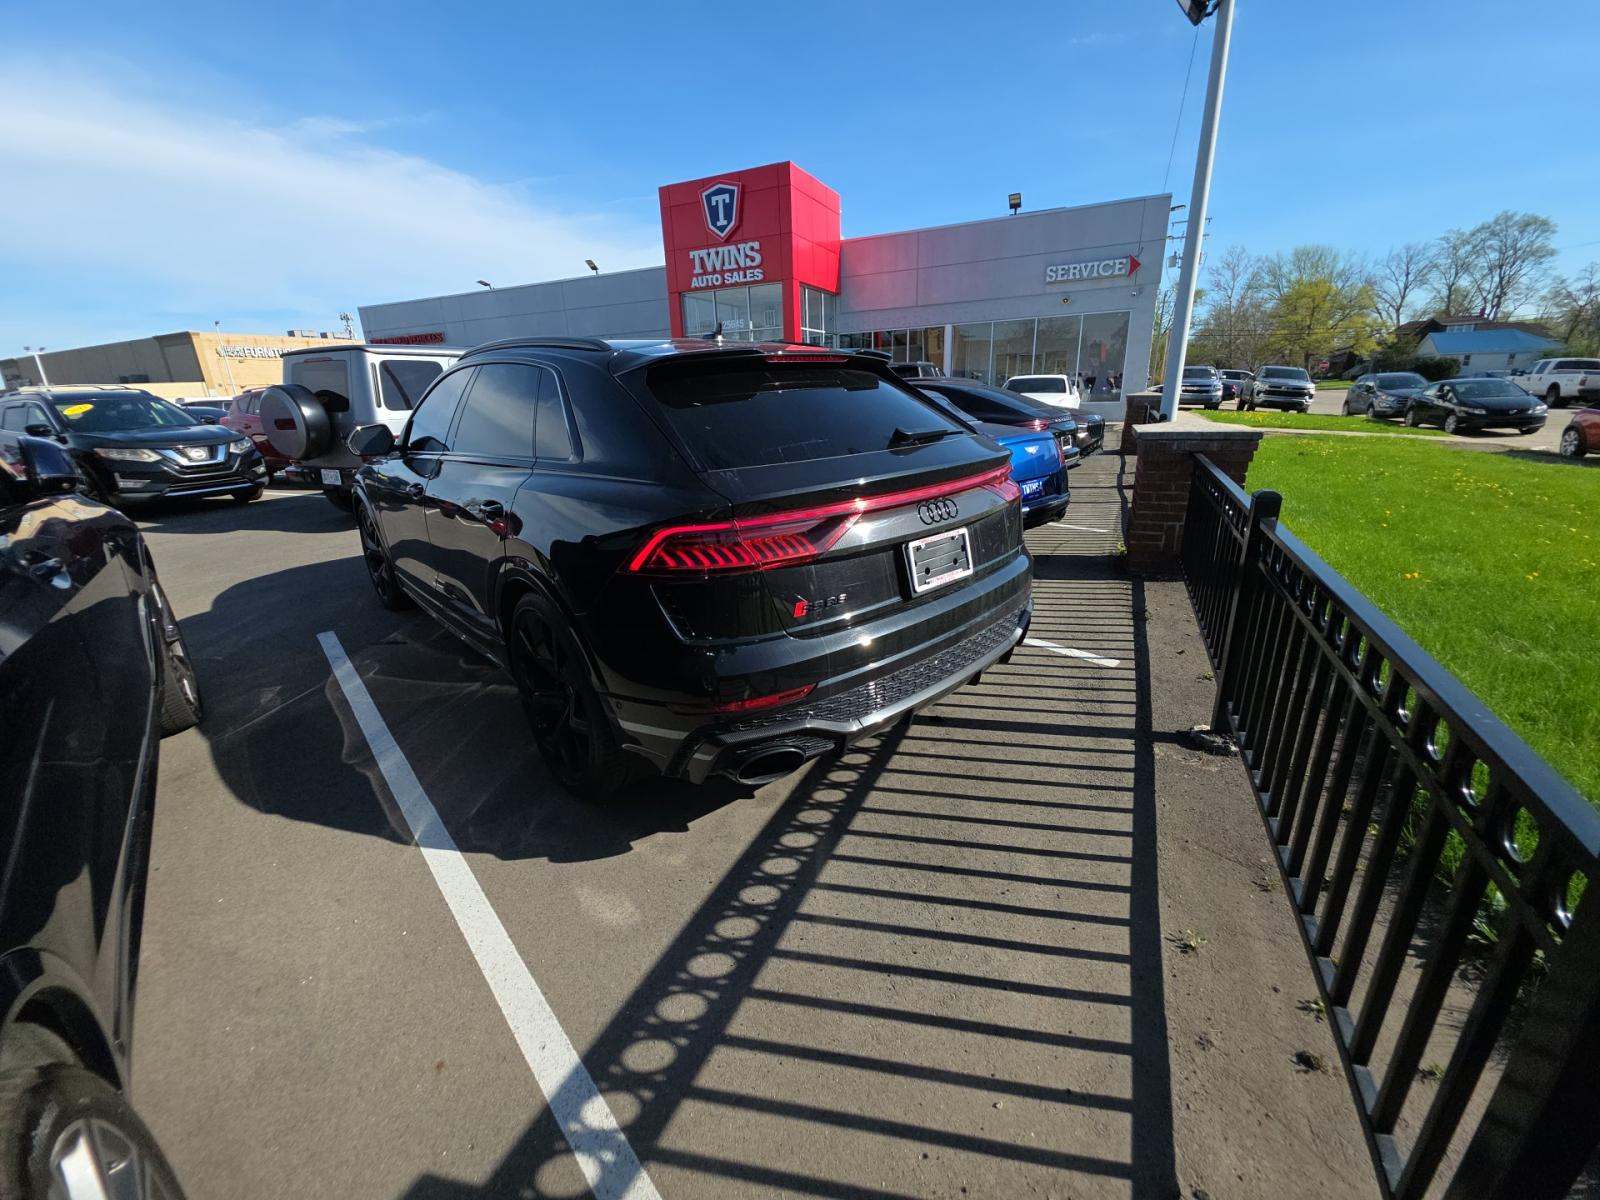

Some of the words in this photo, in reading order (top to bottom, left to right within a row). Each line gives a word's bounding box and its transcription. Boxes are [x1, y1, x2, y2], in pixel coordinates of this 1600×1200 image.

[711, 193, 729, 226] T
[689, 241, 762, 274] TWINS
[1046, 258, 1126, 282] SERVICE
[691, 274, 721, 288] AUTO
[724, 268, 764, 283] SALES
